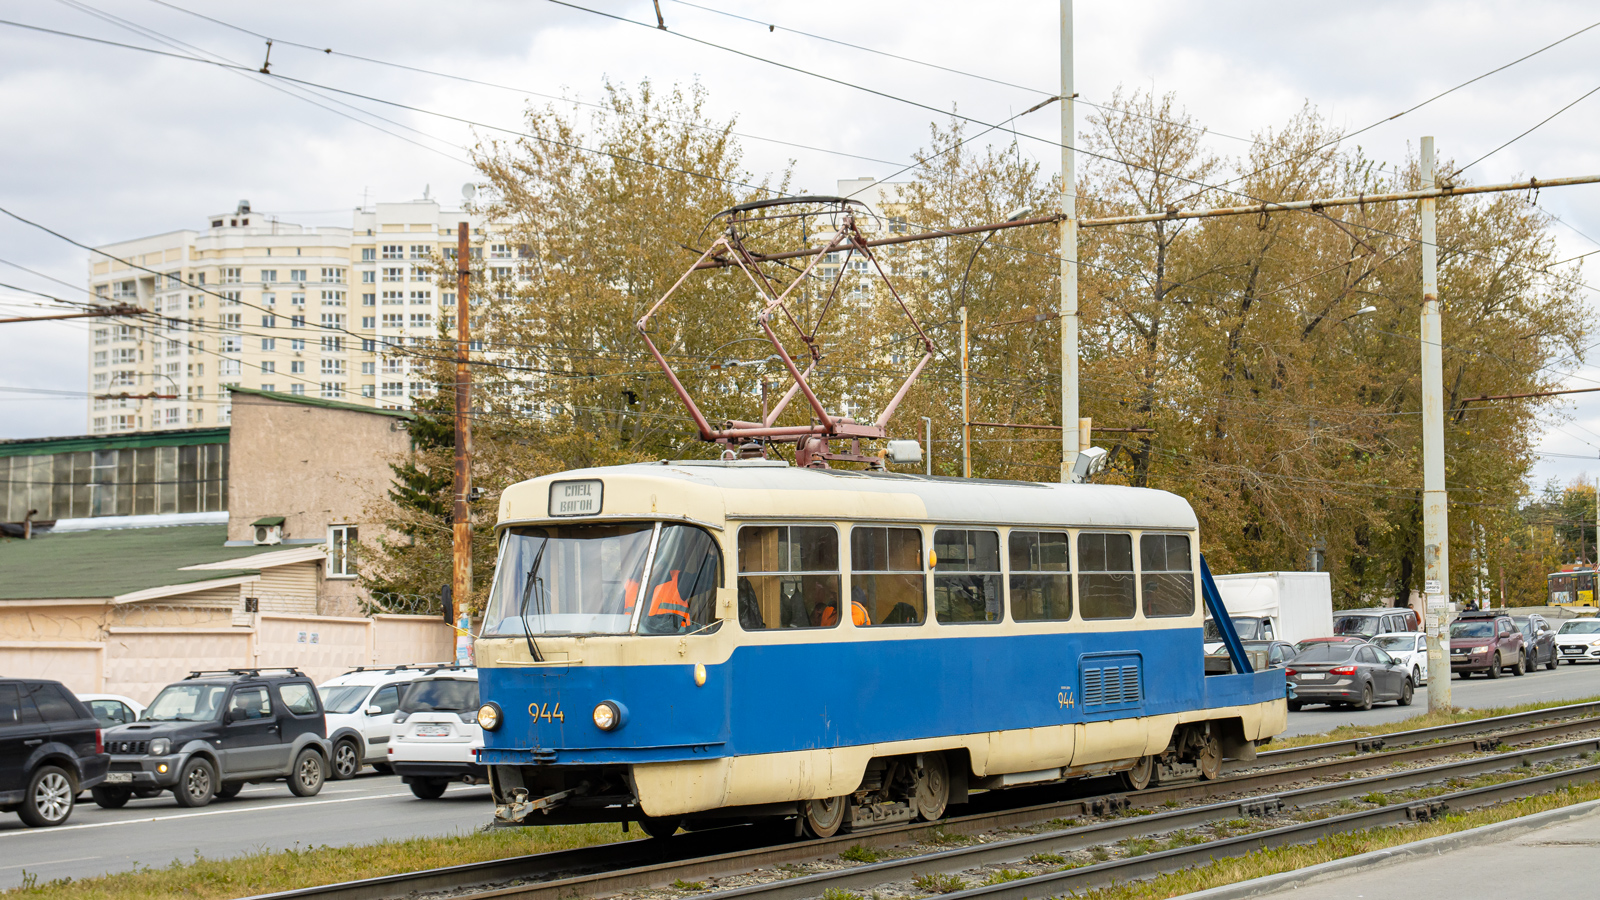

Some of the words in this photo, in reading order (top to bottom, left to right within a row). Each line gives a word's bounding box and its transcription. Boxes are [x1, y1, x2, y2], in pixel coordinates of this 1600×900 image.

[565, 484, 591, 497] СПЕЦ
[560, 499, 592, 512] ВАГОН
[1058, 692, 1074, 709] 944
[528, 703, 565, 723] 944
